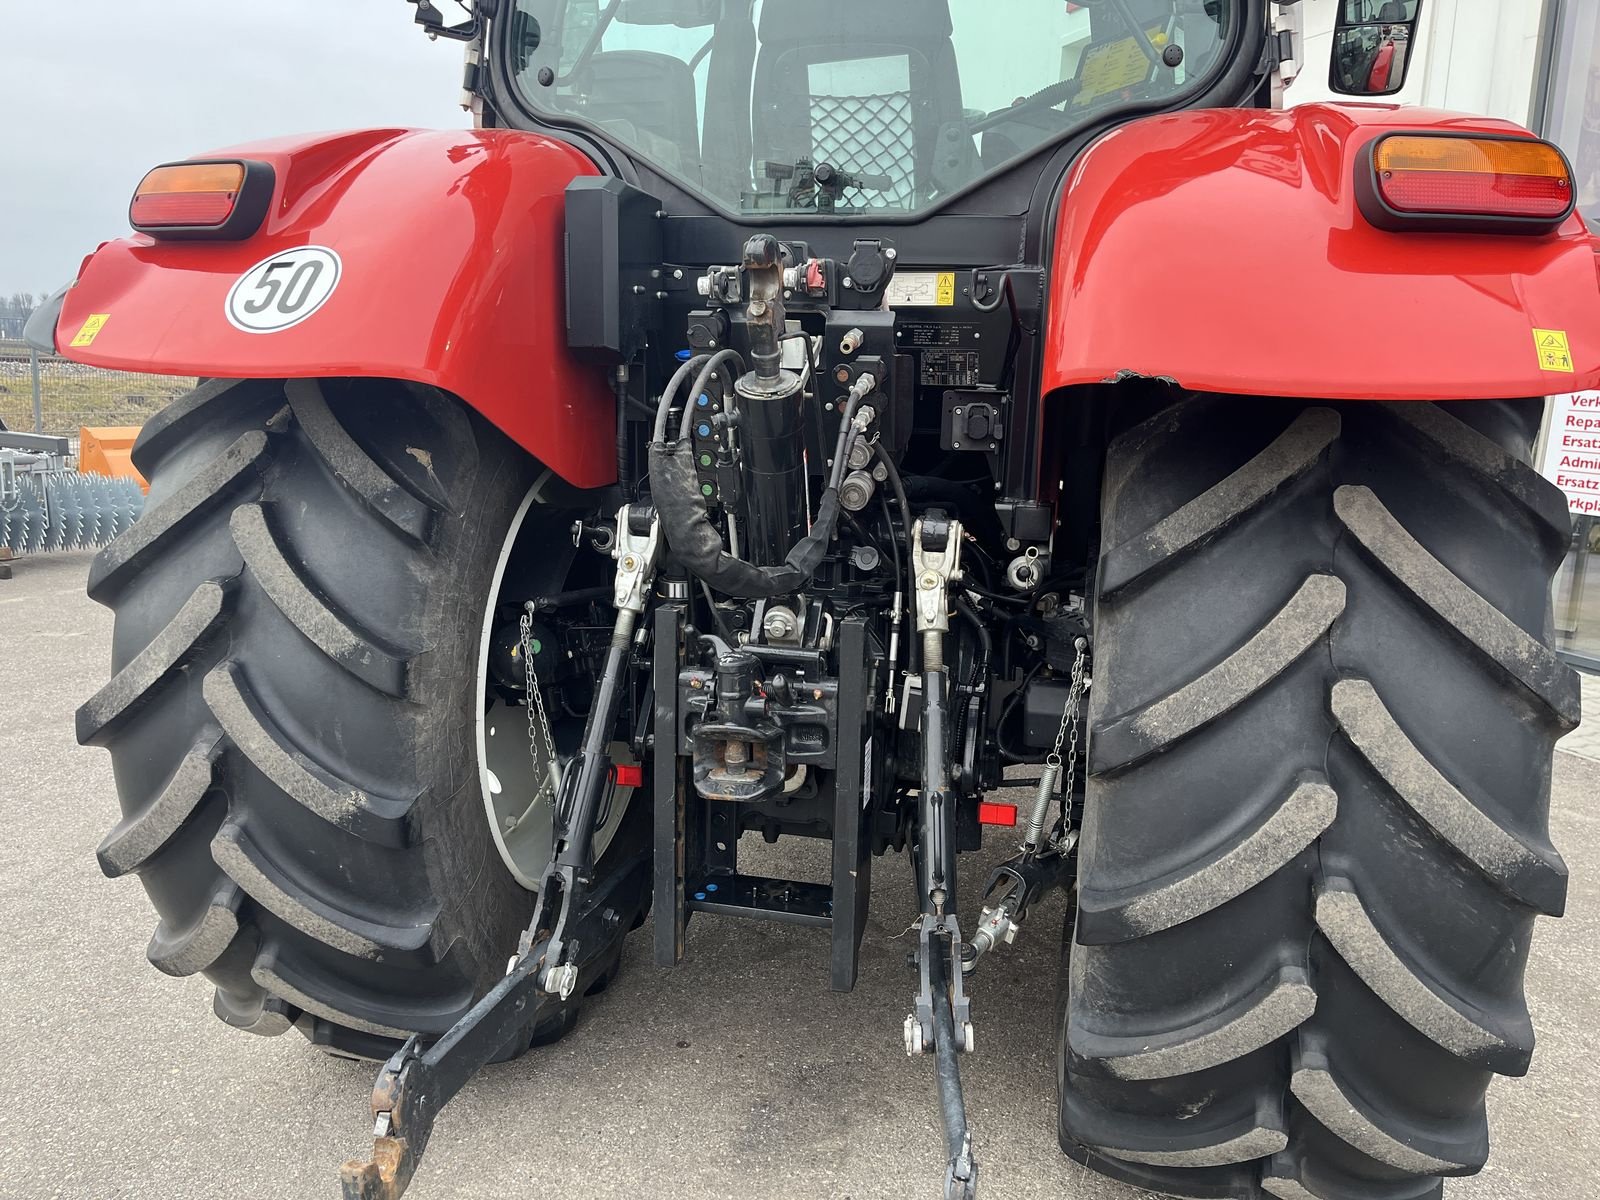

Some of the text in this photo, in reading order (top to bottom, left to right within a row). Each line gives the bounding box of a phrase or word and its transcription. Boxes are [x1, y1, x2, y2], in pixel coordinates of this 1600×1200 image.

[244, 260, 324, 314] 50
[1565, 415, 1600, 430] Repa
[1562, 435, 1600, 449] Ersat
[1559, 456, 1600, 469] Admi
[1556, 475, 1599, 490] Ersatz
[1569, 497, 1600, 513] rkpl
